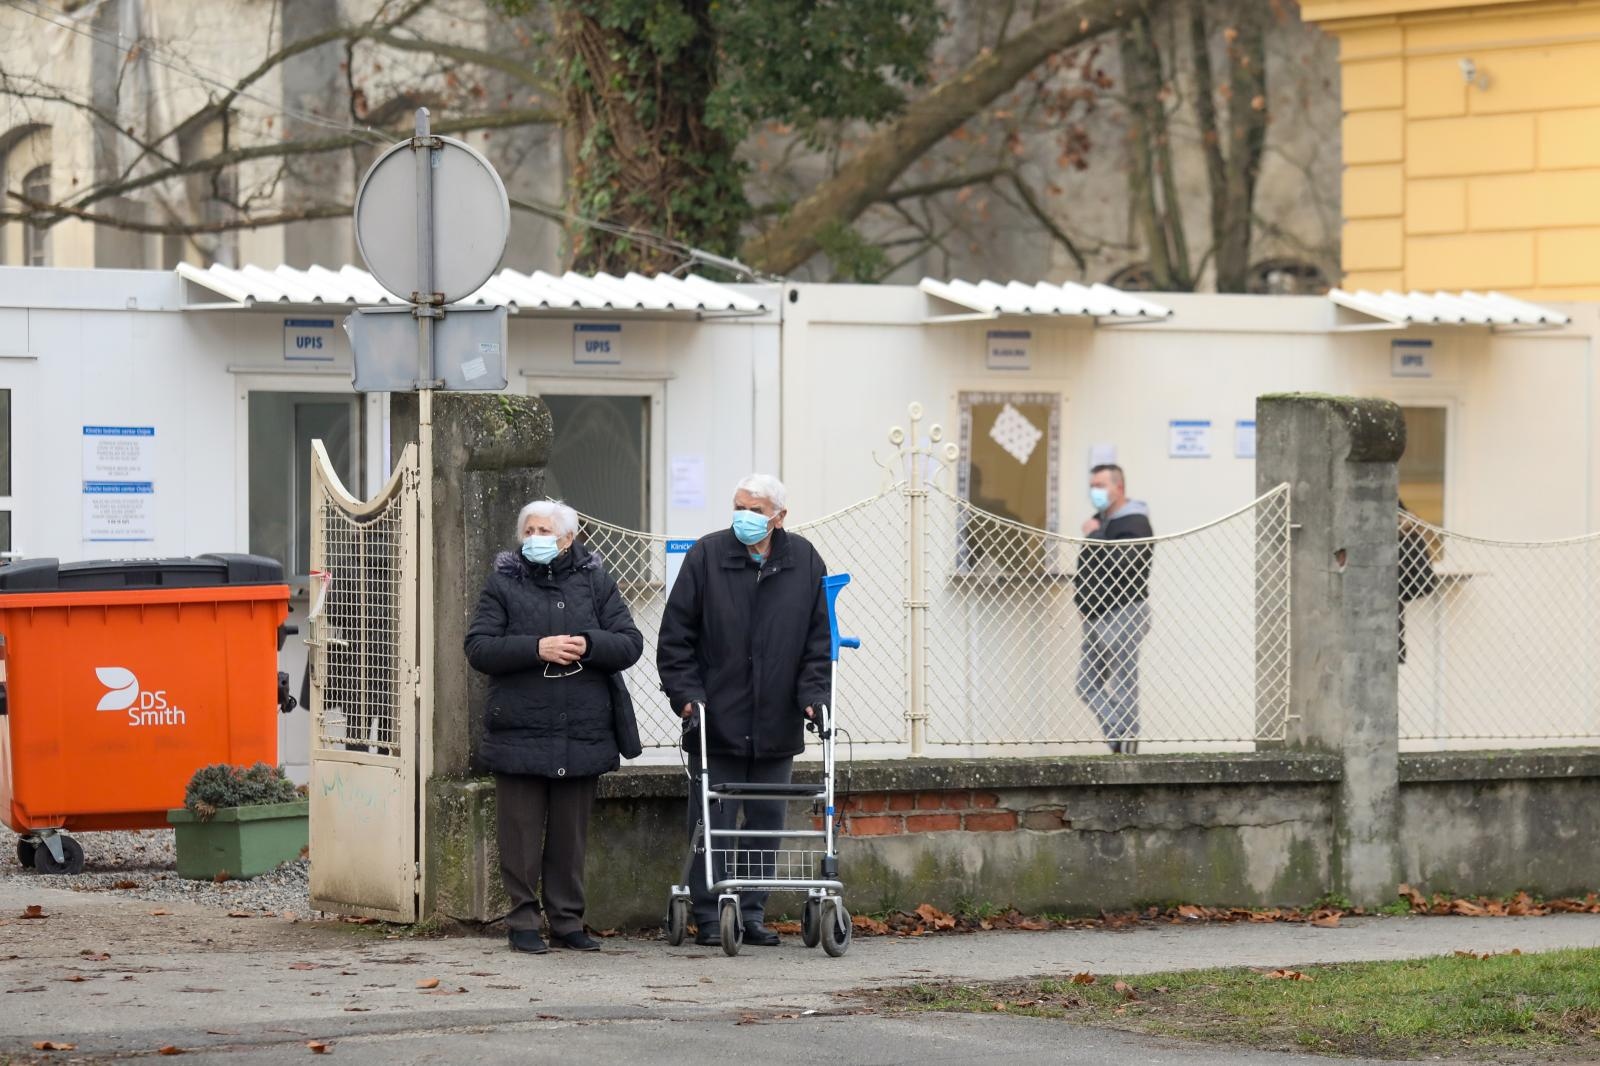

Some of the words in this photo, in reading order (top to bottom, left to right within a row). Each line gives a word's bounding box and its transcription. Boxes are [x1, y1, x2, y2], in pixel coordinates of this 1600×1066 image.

[296, 336, 322, 349] UPIS
[585, 340, 610, 353] UPIS
[140, 690, 167, 710] DS
[128, 705, 186, 726] Smith
